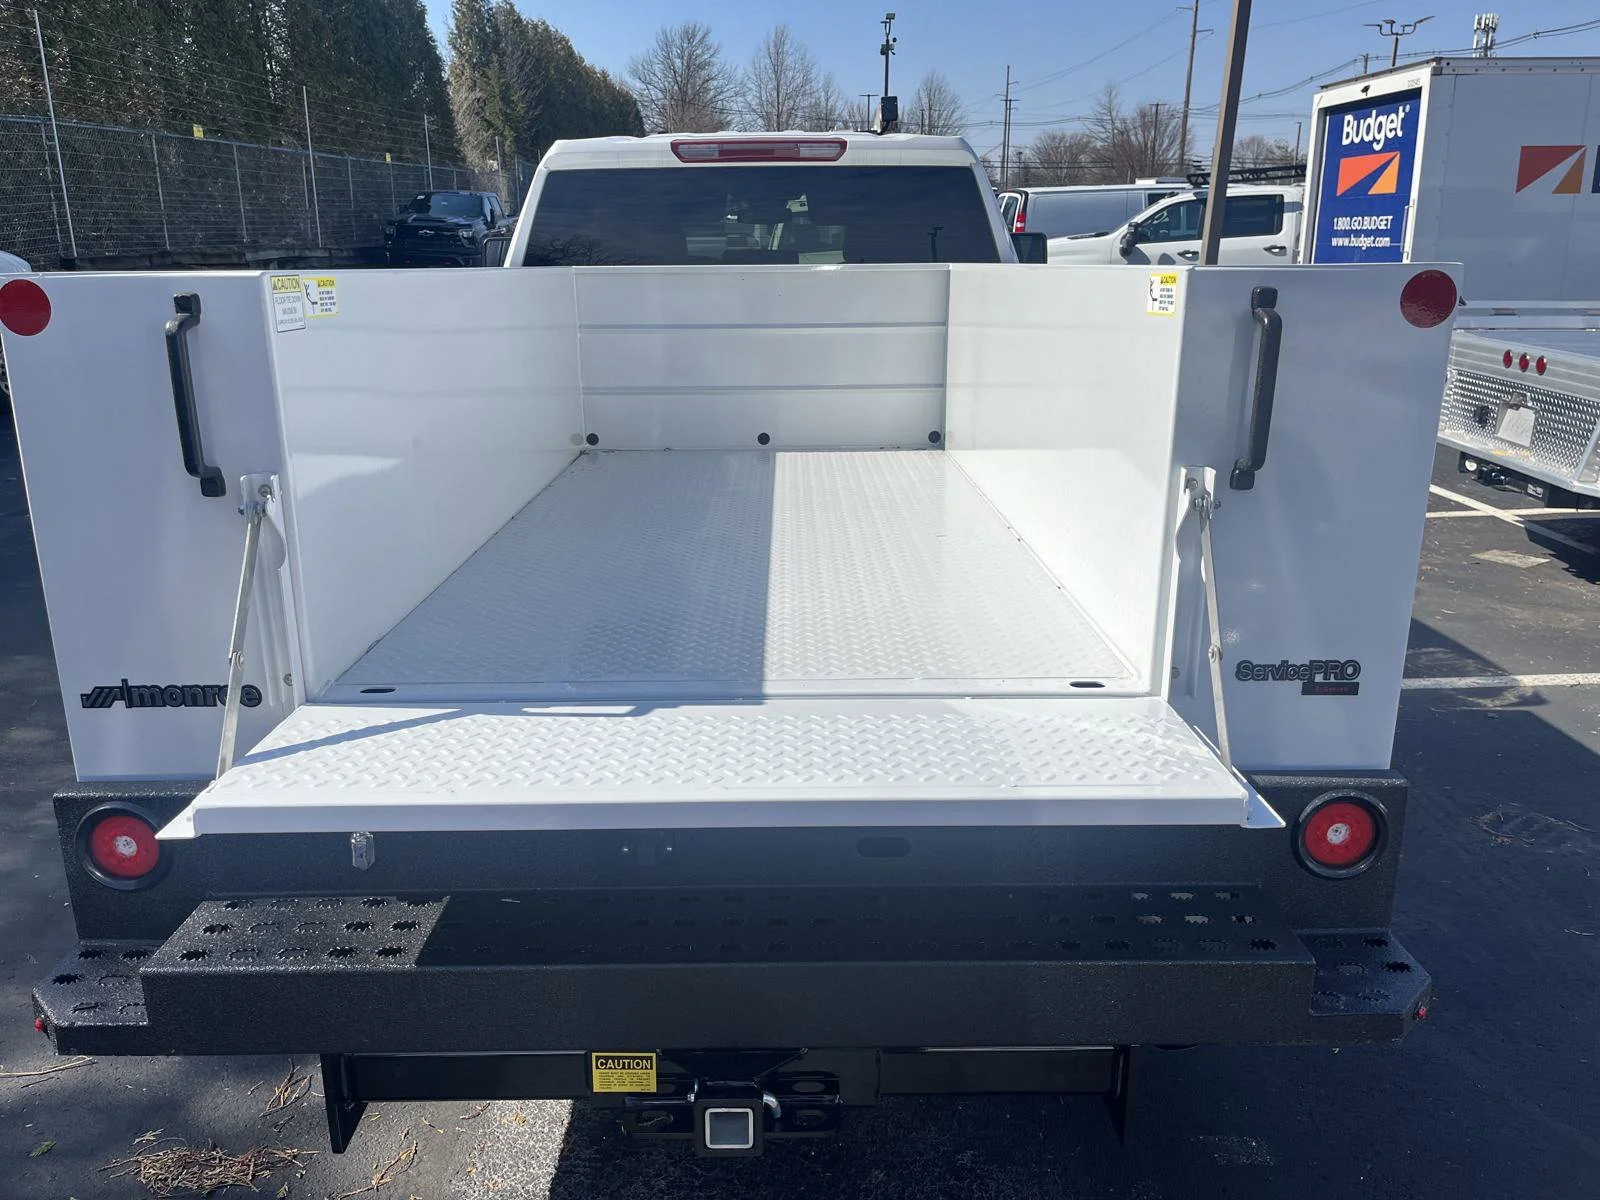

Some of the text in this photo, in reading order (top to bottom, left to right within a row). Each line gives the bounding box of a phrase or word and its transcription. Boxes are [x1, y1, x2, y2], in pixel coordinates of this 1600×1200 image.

[1342, 105, 1405, 151] Budget
[1331, 233, 1391, 250] www.budget.com
[277, 277, 300, 291] CAUTION
[320, 279, 335, 287] CAUTION
[1162, 275, 1177, 284] CAUTION
[1235, 659, 1361, 682] ServicePRO
[597, 1059, 651, 1069] CAUTION
